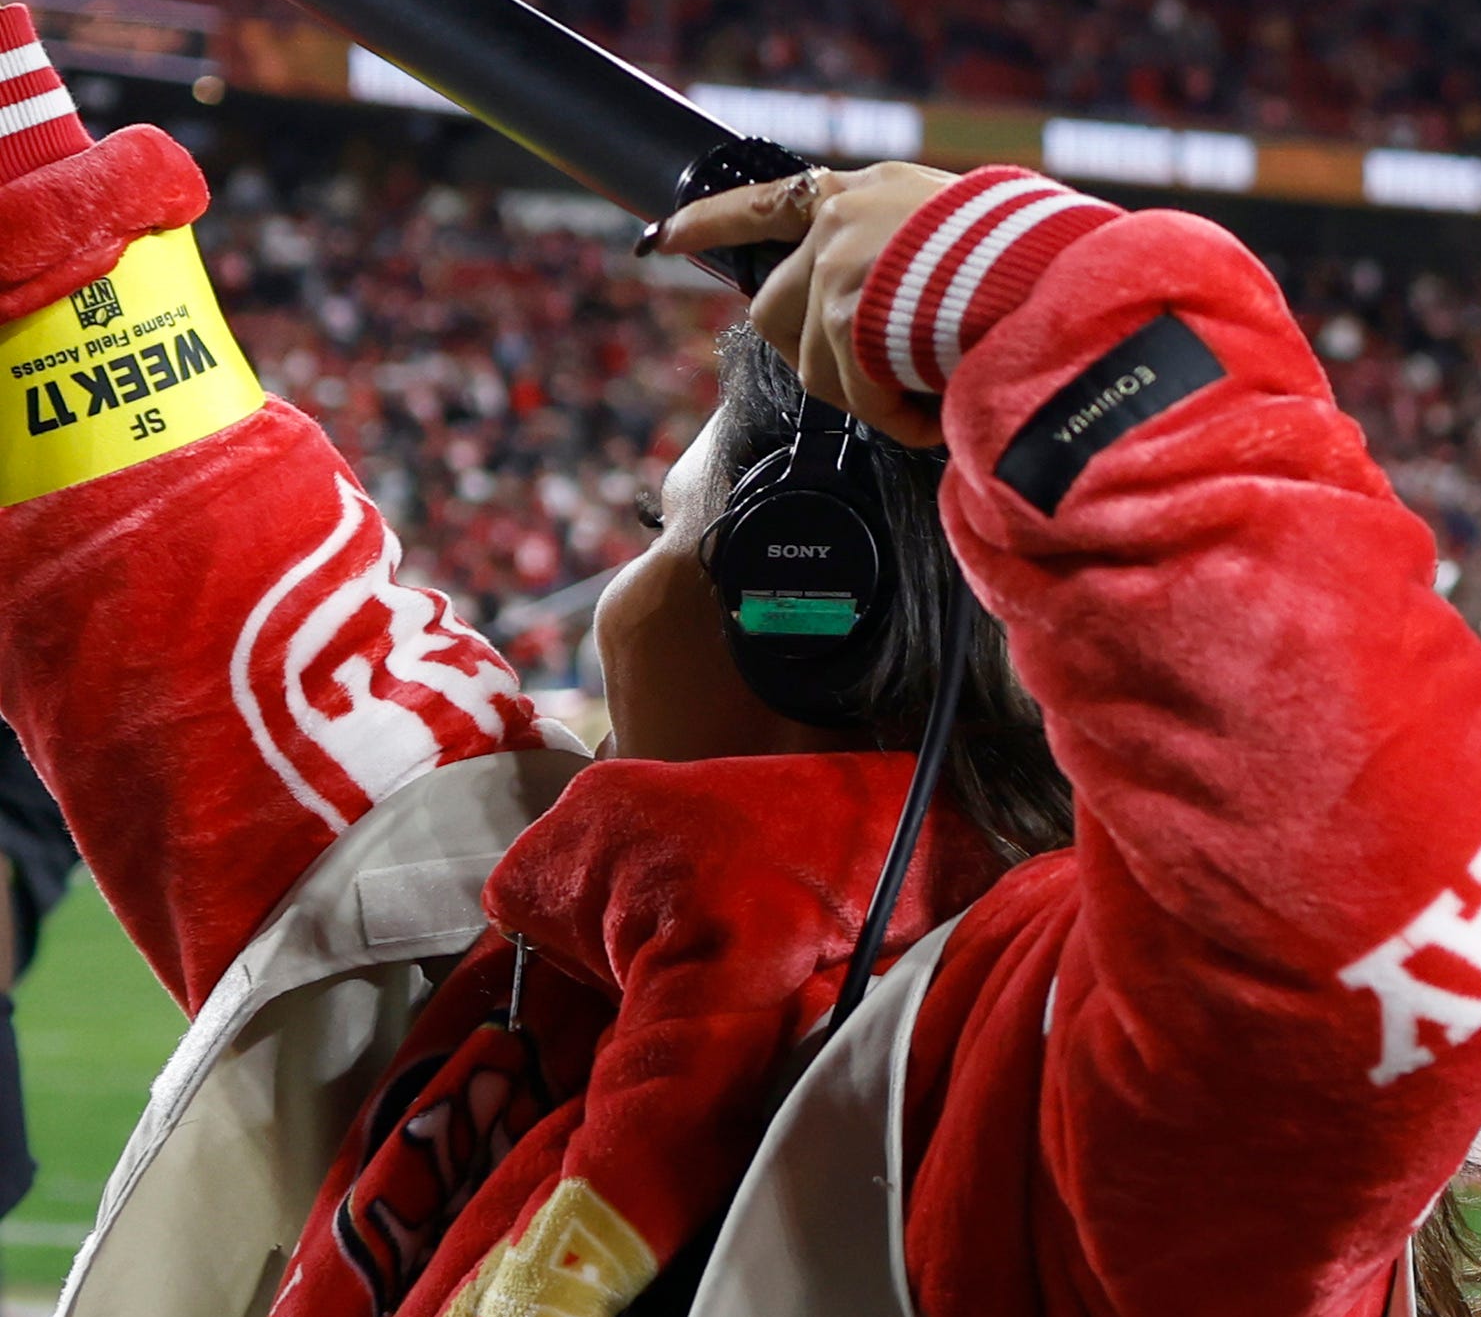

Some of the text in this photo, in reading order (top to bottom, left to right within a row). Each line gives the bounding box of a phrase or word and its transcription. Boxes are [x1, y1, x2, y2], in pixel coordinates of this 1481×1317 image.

[11, 303, 191, 380] In-Game Field Access
[26, 328, 218, 438] WEEK 17
[129, 407, 168, 442] SF
[767, 543, 832, 559] SONY
